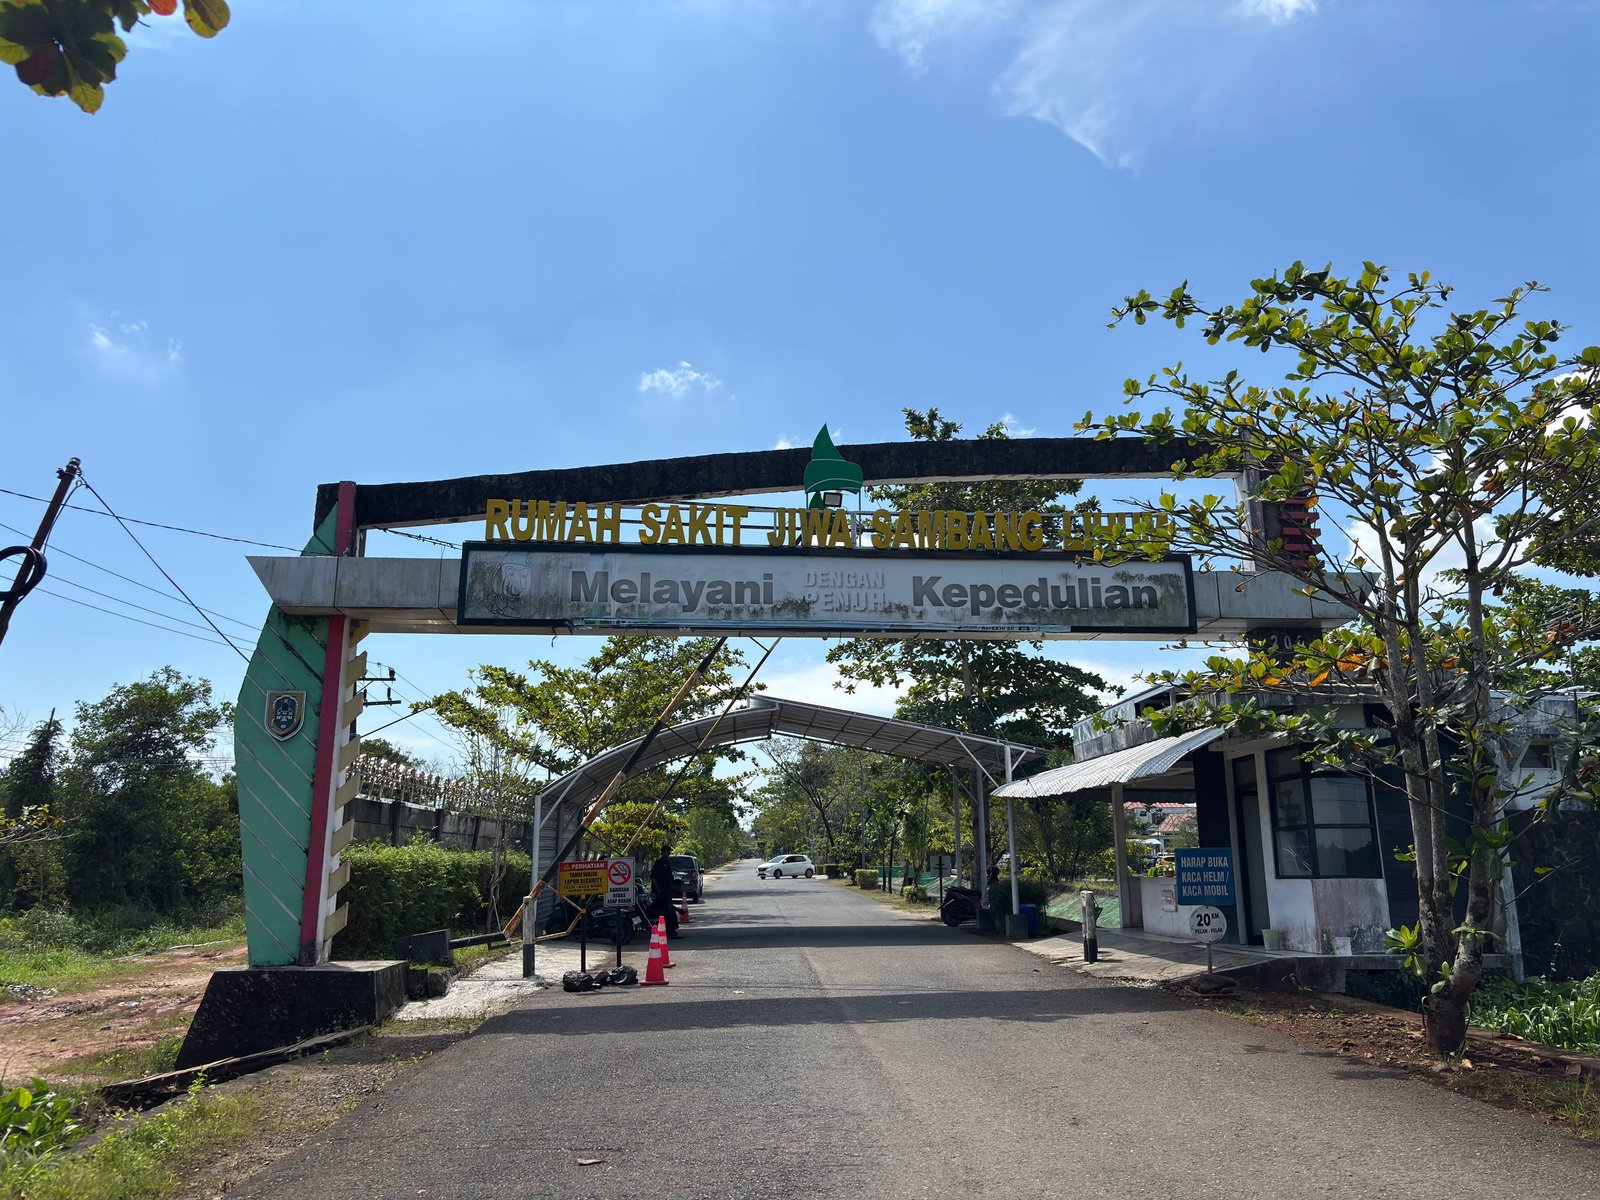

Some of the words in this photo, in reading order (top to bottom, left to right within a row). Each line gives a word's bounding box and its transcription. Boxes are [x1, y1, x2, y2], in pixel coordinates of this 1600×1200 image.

[485, 499, 621, 544] RUMAH
[638, 504, 748, 547] SAKIT
[767, 507, 852, 548] JIWA
[871, 508, 1044, 552] SAMBANG
[805, 571, 884, 588] DENGAN
[571, 570, 774, 613] Melayani
[912, 575, 1158, 616] Kepedulian
[805, 592, 885, 612] PENUH
[571, 862, 605, 870] PERHATIAN
[1181, 857, 1206, 868] HARAP
[1208, 857, 1229, 867] BUKA
[1182, 872, 1202, 882] KACA
[1203, 872, 1225, 882] HELM
[1182, 886, 1202, 896] KACA
[1204, 885, 1229, 896] MOBIL
[1196, 913, 1211, 927] 20
